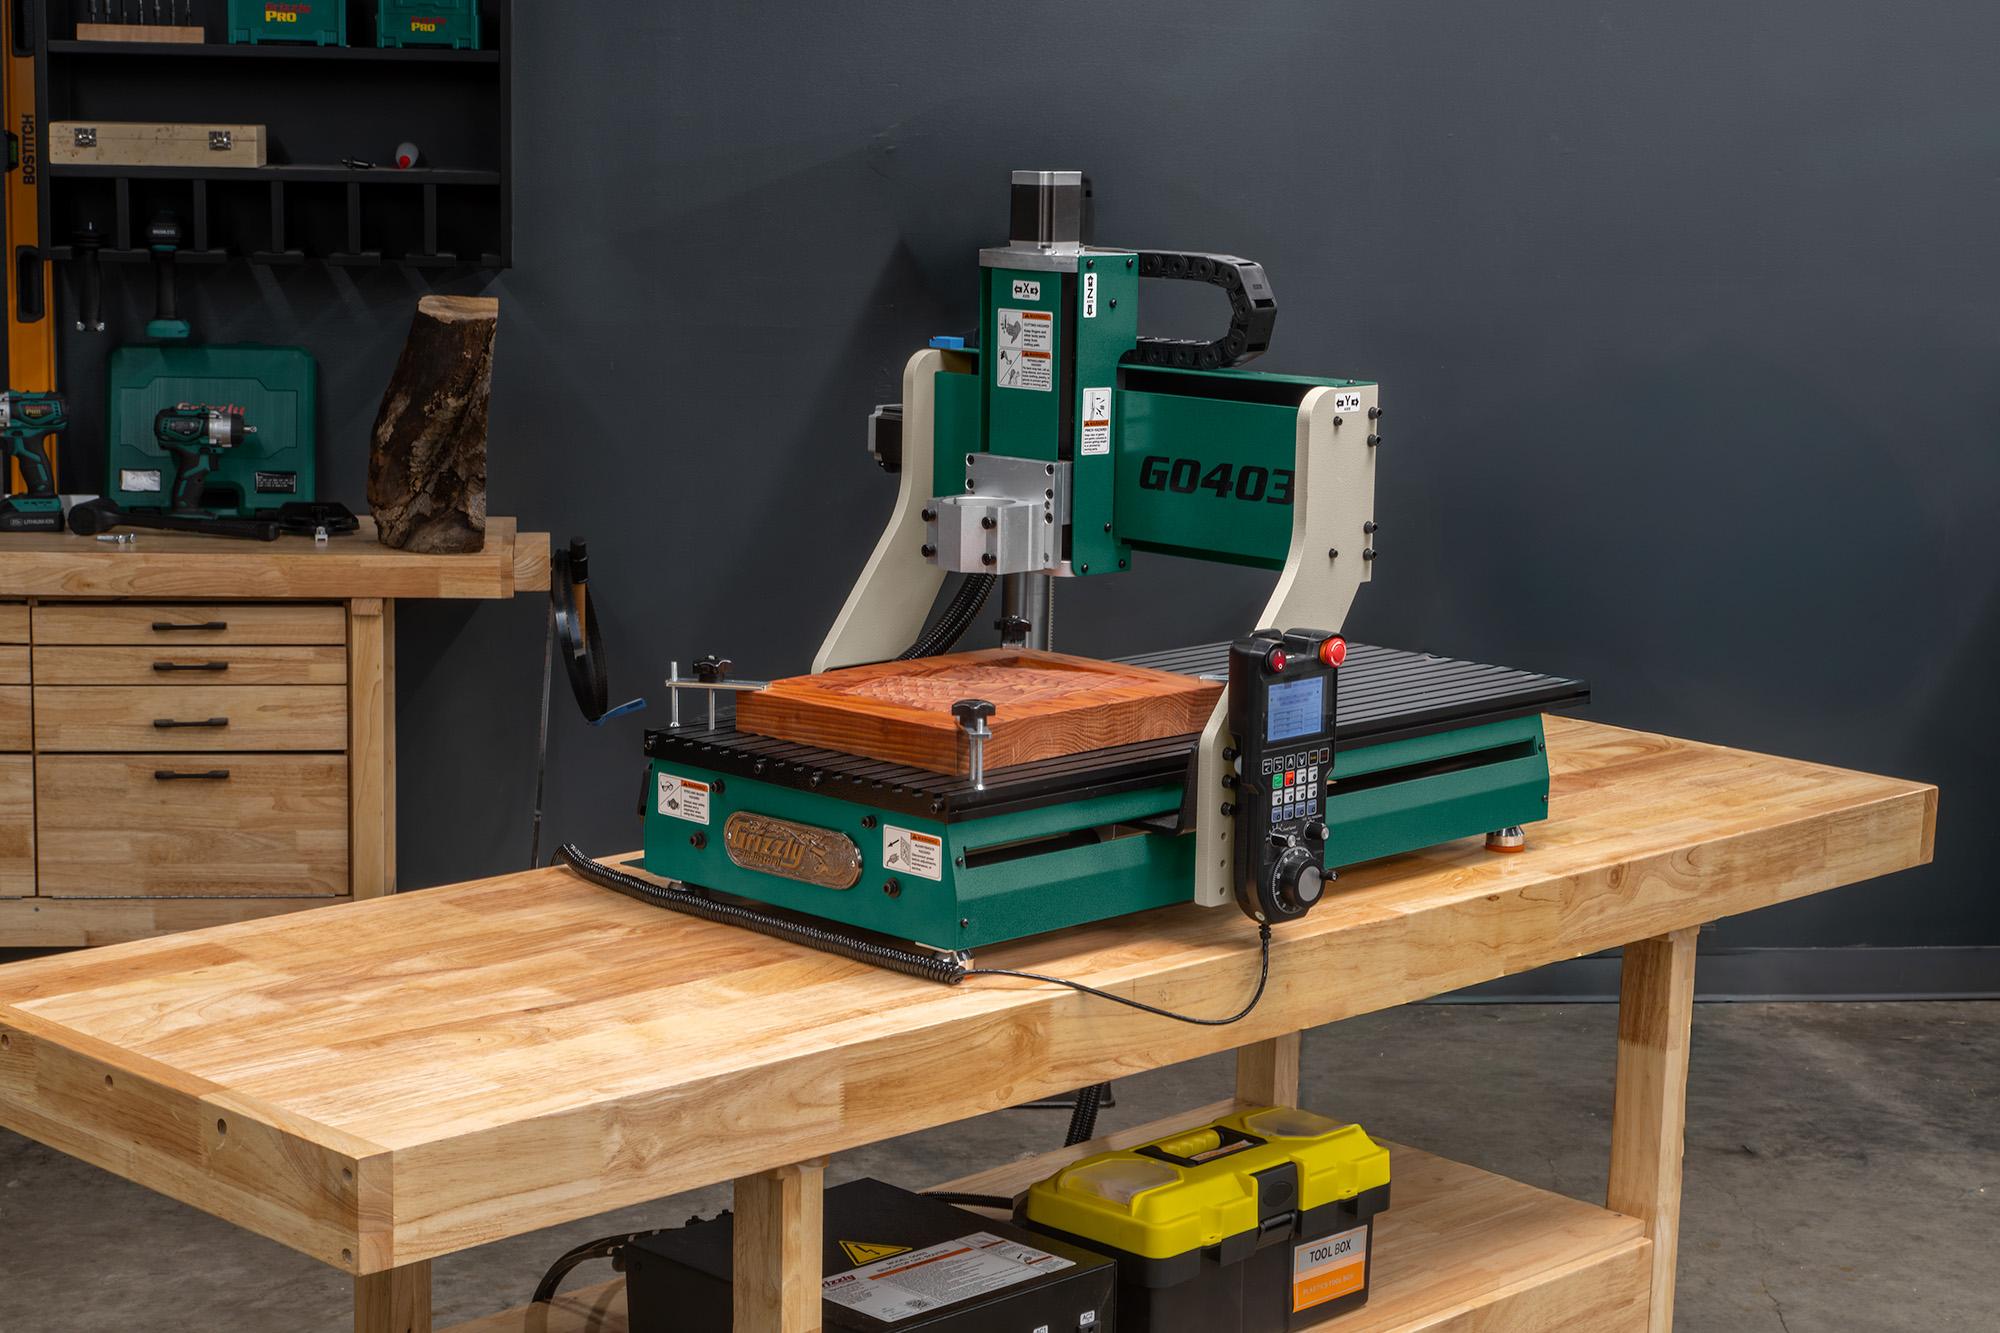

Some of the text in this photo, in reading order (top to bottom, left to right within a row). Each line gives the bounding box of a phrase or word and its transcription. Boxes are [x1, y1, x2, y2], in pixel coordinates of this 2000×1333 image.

[265, 10, 297, 23] PRO
[411, 22, 436, 32] PRO
[21, 113, 36, 185] BOSTITCH
[1023, 282, 1030, 294] X
[1087, 288, 1094, 299] Z
[1344, 395, 1351, 406] Y
[1139, 455, 1295, 506] G0403
[731, 821, 807, 870] Grizzly
[1309, 1239, 1352, 1263] TOOL BOX
